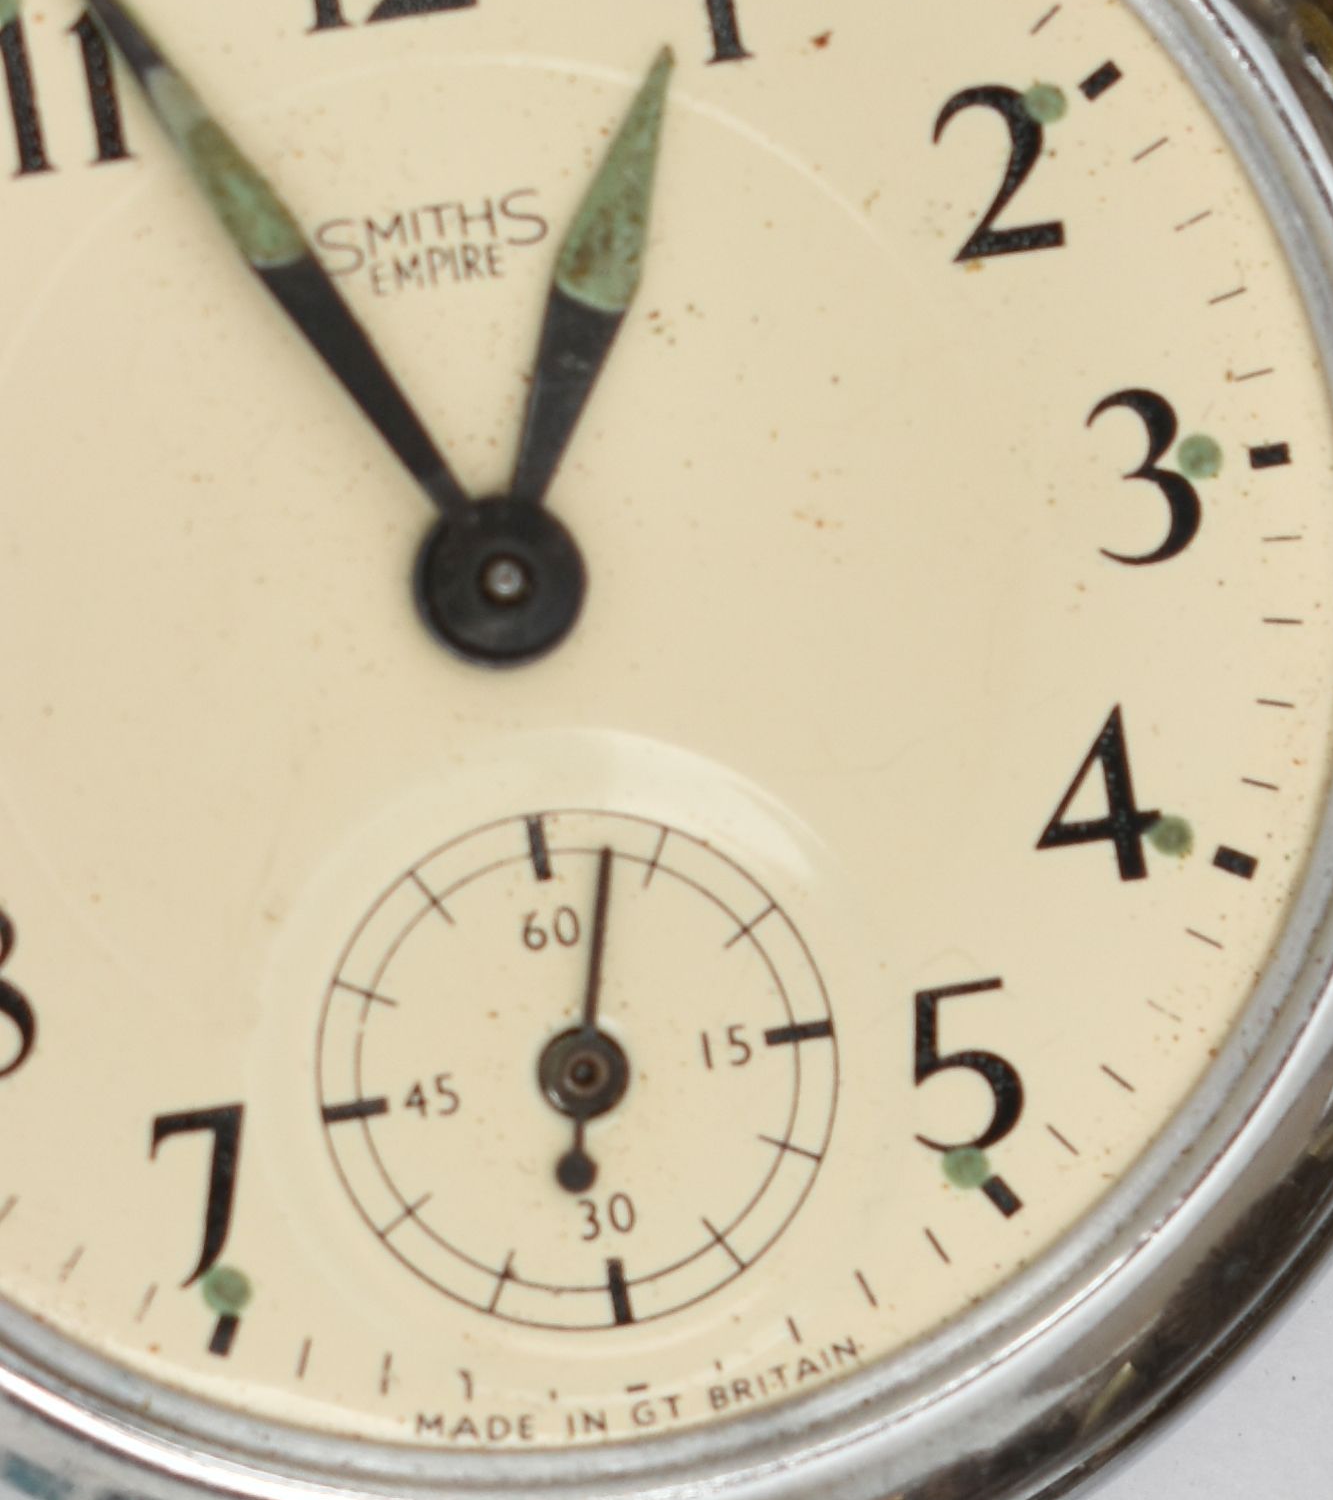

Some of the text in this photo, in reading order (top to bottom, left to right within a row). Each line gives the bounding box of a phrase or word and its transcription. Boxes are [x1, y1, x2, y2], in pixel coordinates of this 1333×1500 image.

[0, 8, 137, 178] 11
[931, 84, 1066, 263] 2
[315, 187, 549, 277] SMITHS
[369, 242, 505, 298] EMPIRE
[1084, 388, 1202, 566] 3
[1035, 703, 1162, 882] 4
[522, 905, 580, 951] 60
[404, 1073, 460, 1117] 45
[701, 1024, 752, 1071] 15
[914, 977, 1024, 1154] 5
[148, 1103, 244, 1290] 7
[577, 1192, 636, 1241] 30
[415, 1336, 860, 1440] MADE IN GT BRITAIN
